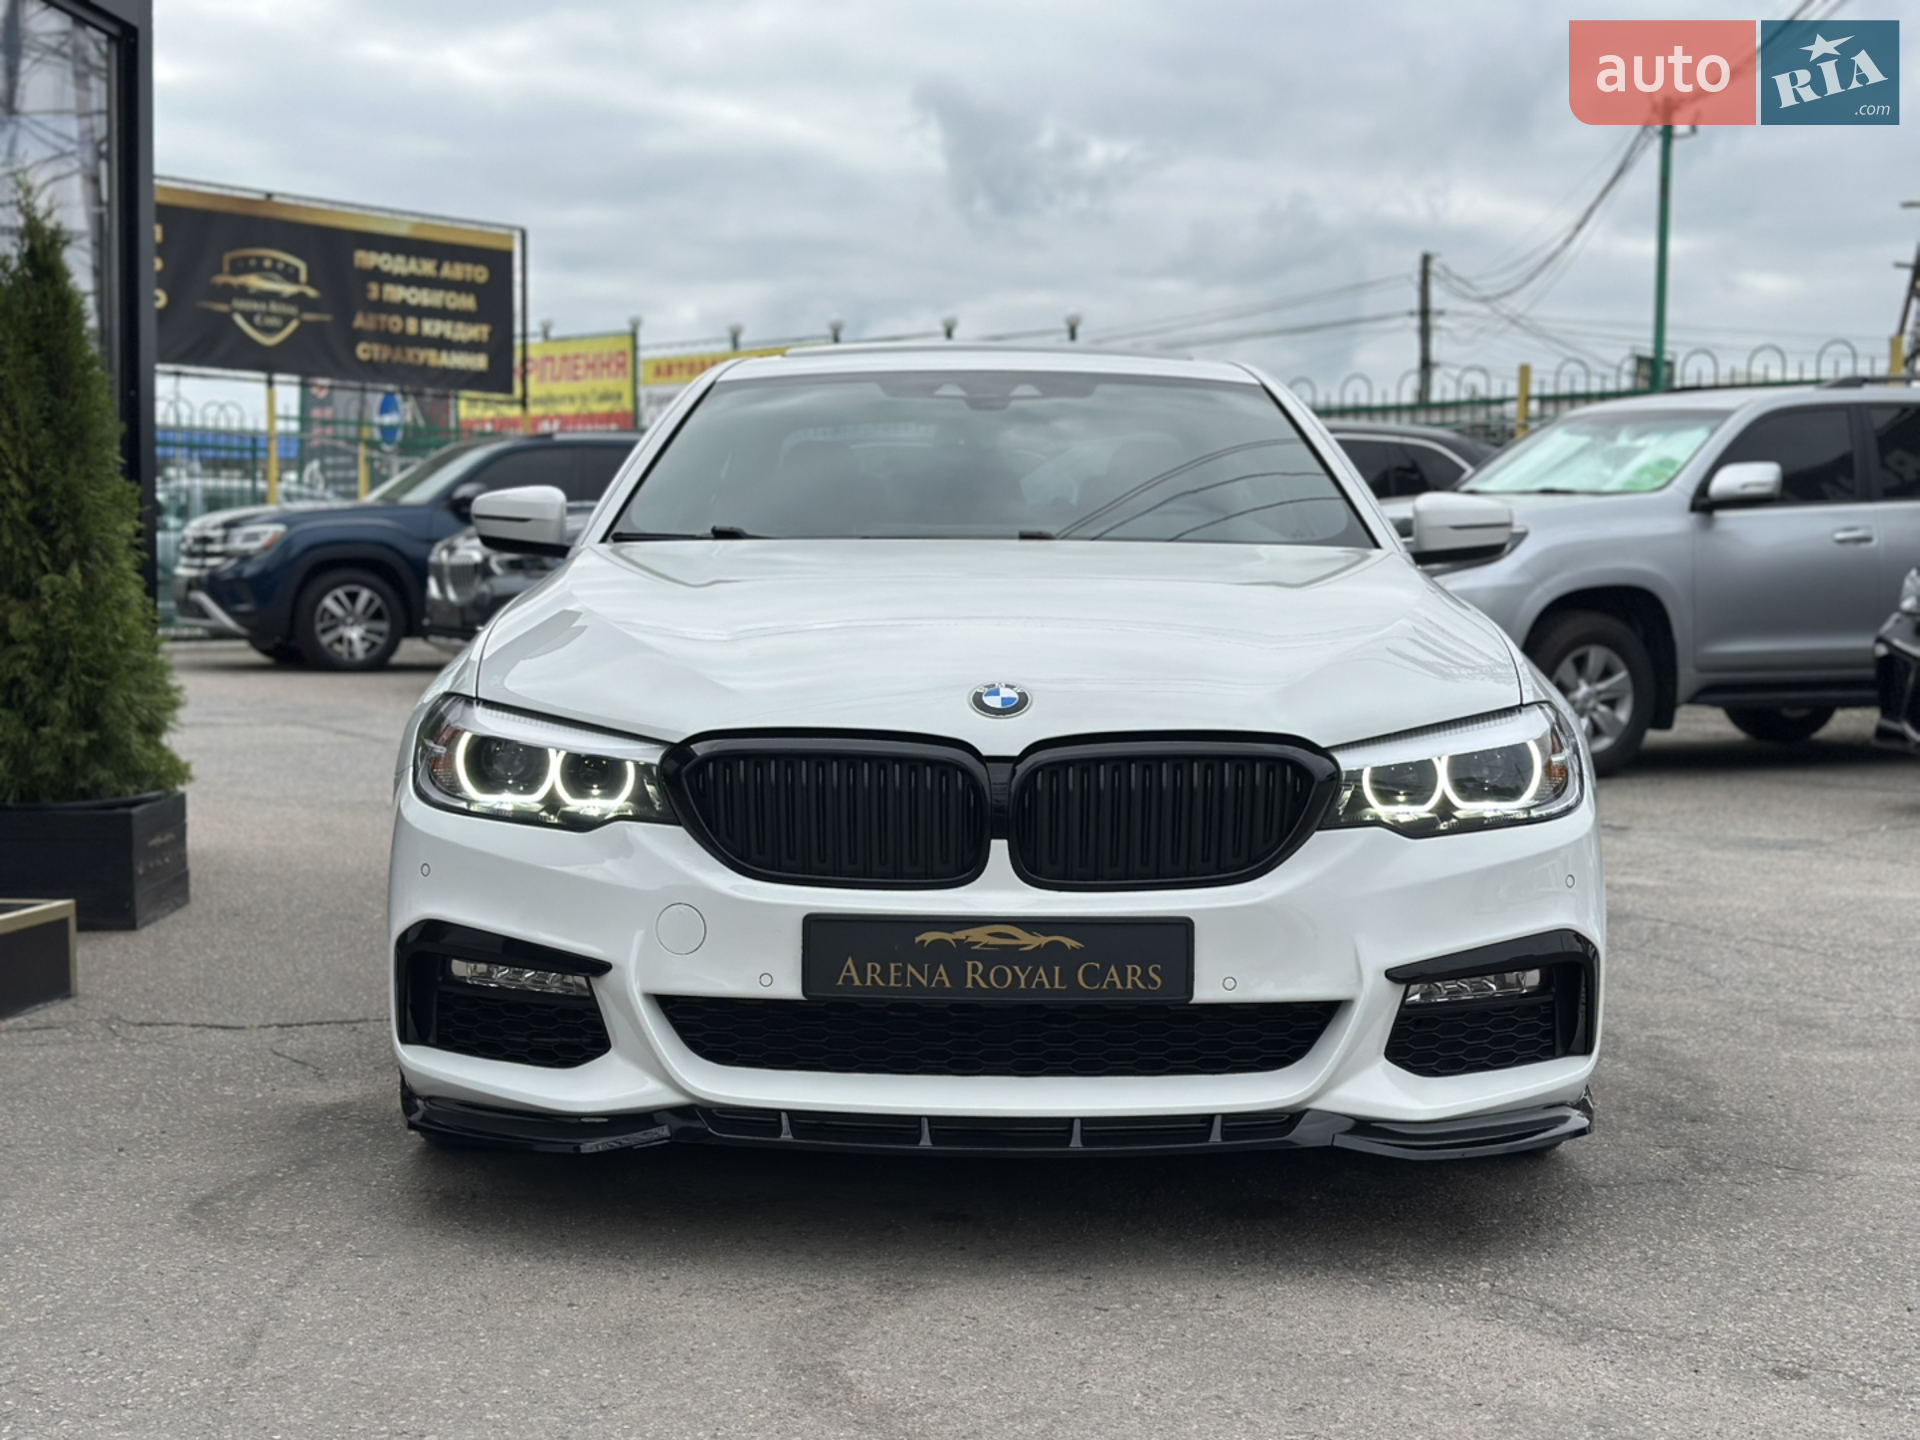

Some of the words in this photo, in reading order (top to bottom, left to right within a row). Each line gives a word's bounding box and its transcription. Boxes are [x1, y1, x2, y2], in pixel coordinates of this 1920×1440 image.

[353, 249, 438, 278] ПРОДАЖ
[439, 260, 490, 285] АВТО
[352, 310, 404, 334] АВТО
[420, 316, 492, 344] КРЕДИТ
[355, 341, 489, 372] СТРАХУВАННЯ
[836, 956, 952, 989] ARENA
[964, 960, 1067, 990] ROYAL
[1077, 962, 1162, 991] CARS
